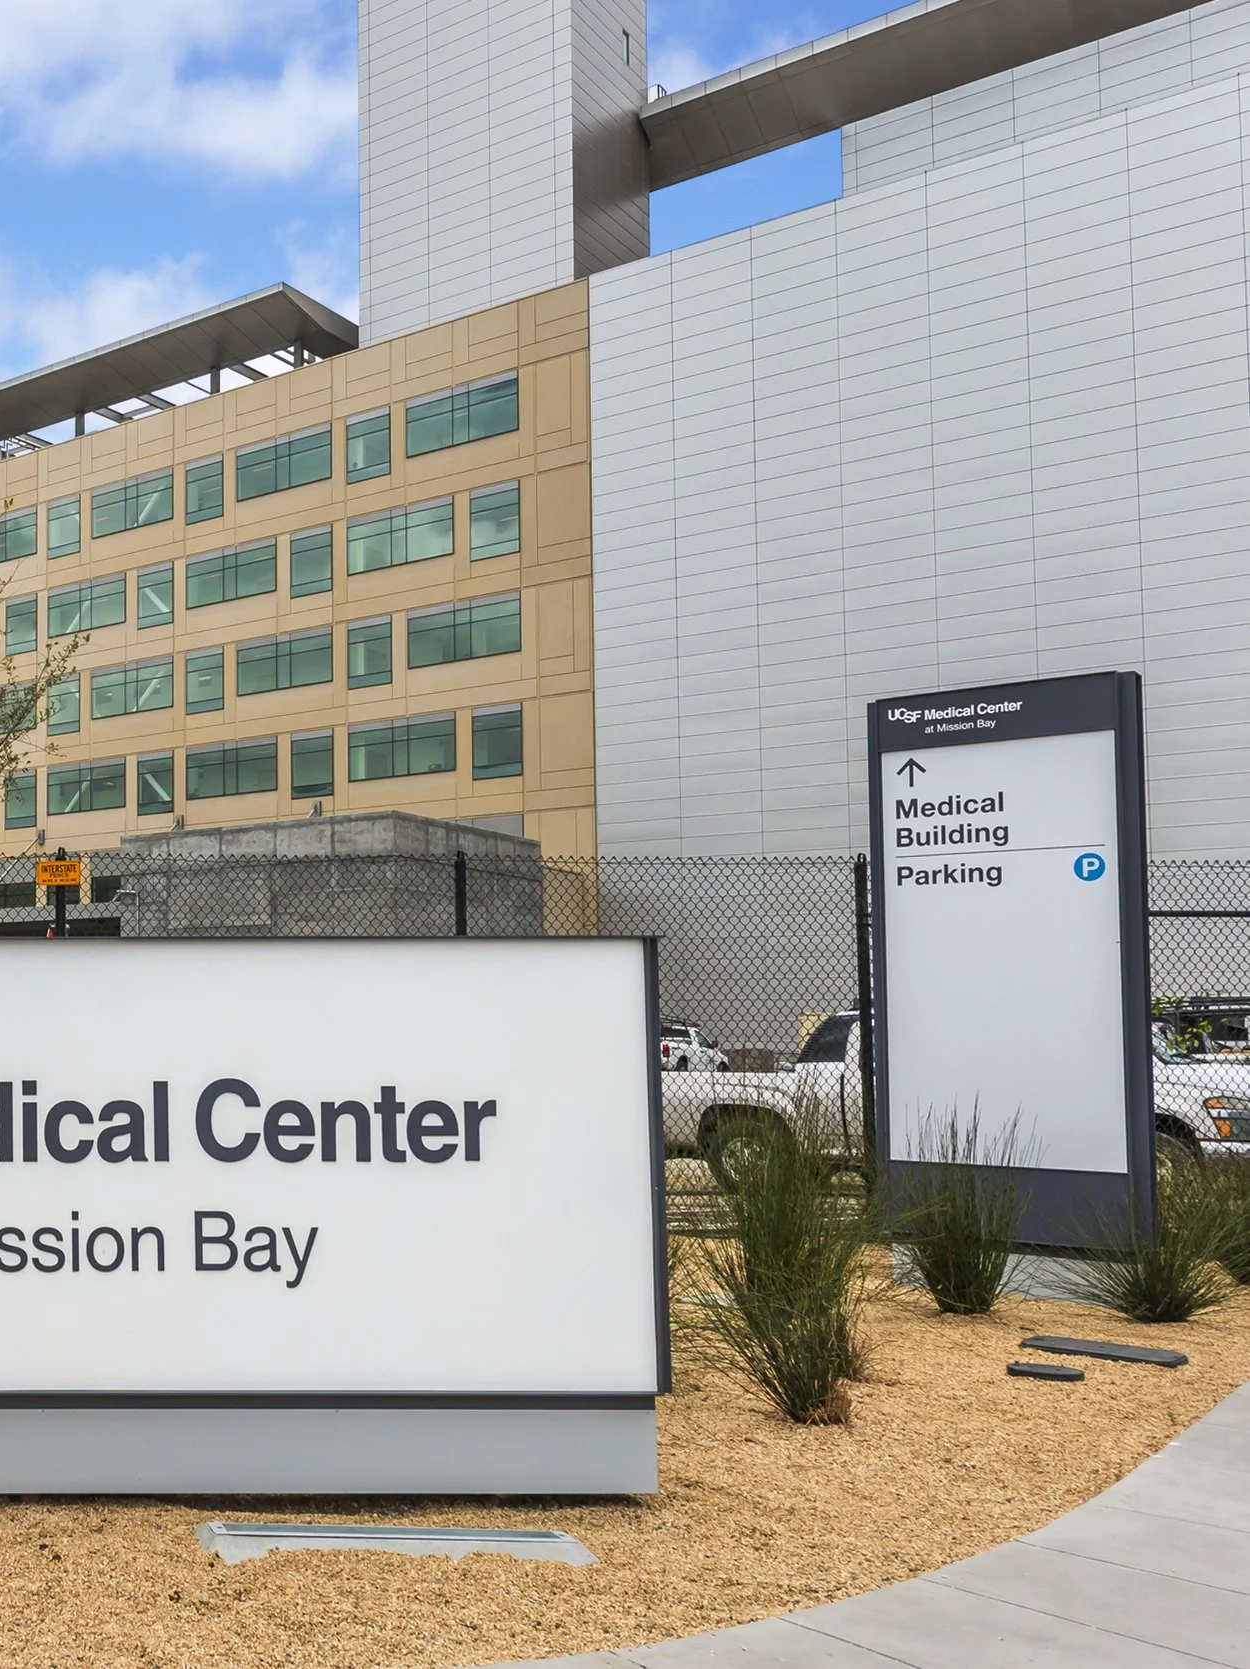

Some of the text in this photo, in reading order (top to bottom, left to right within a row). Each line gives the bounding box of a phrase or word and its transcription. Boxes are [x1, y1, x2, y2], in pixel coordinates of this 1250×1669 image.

[888, 701, 1023, 723] UCSF Medical Center
[924, 718, 997, 734] at Mission Bay
[895, 791, 1004, 819] Medical
[896, 823, 1009, 847] Building
[41, 864, 77, 873] INTERSTATE
[897, 863, 1003, 887] Parking
[1082, 858, 1100, 877] P
[195, 1077, 497, 1164] Center
[193, 1210, 319, 1289] Bay
